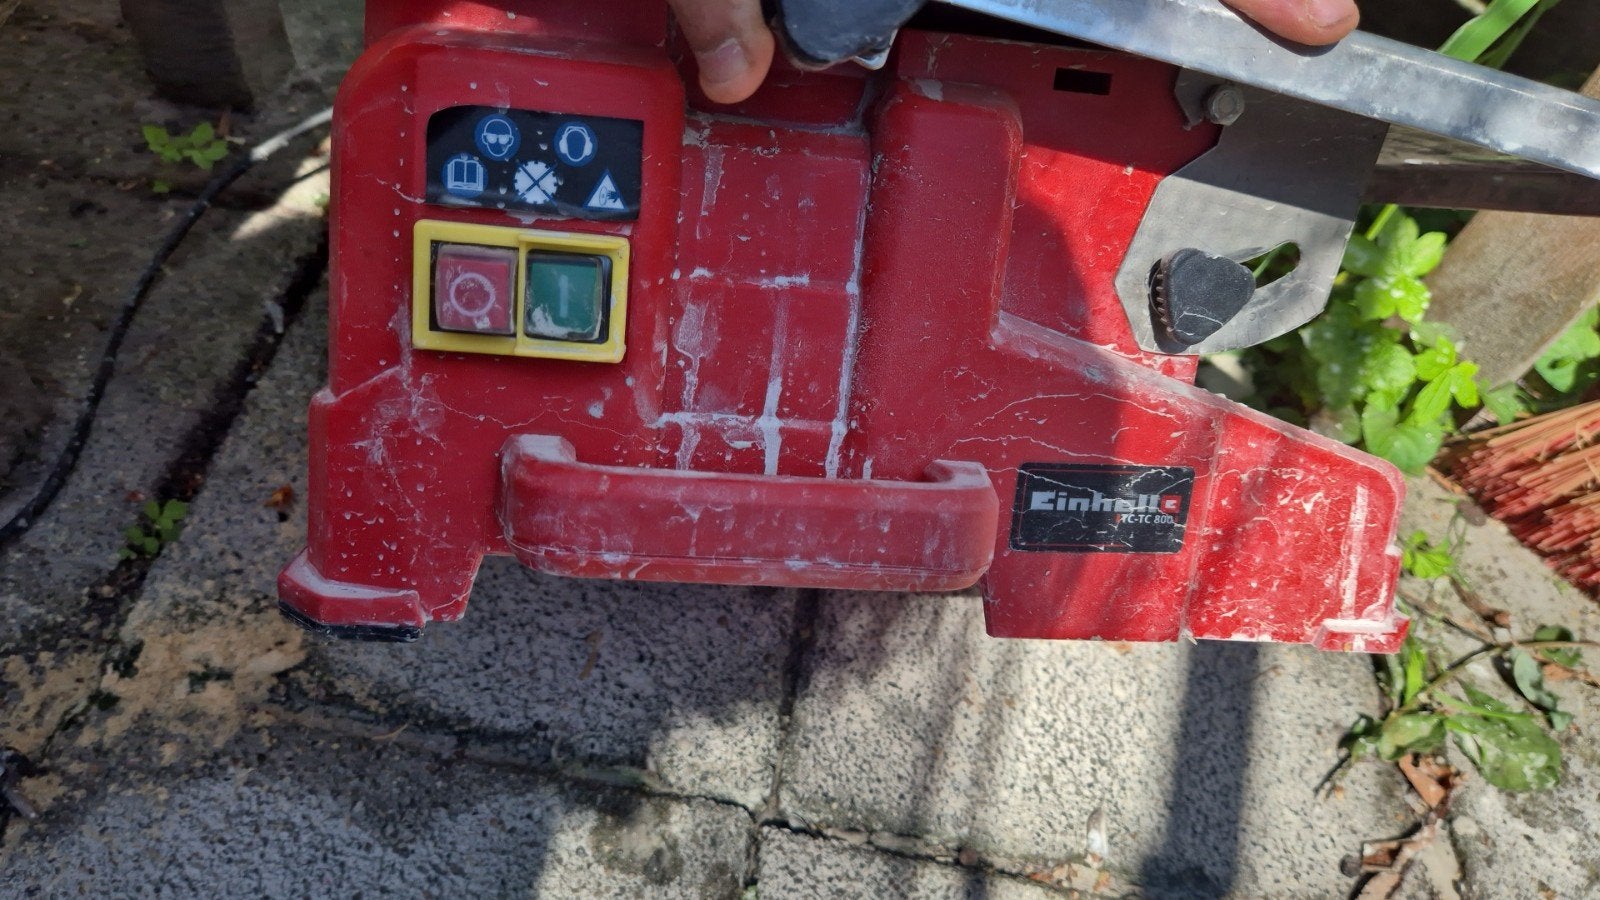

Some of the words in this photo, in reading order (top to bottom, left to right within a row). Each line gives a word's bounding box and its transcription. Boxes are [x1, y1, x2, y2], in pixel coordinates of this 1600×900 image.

[1030, 491, 1160, 512] Einhell
[1121, 513, 1152, 524] TC-TC
[1154, 514, 1174, 525] 800
